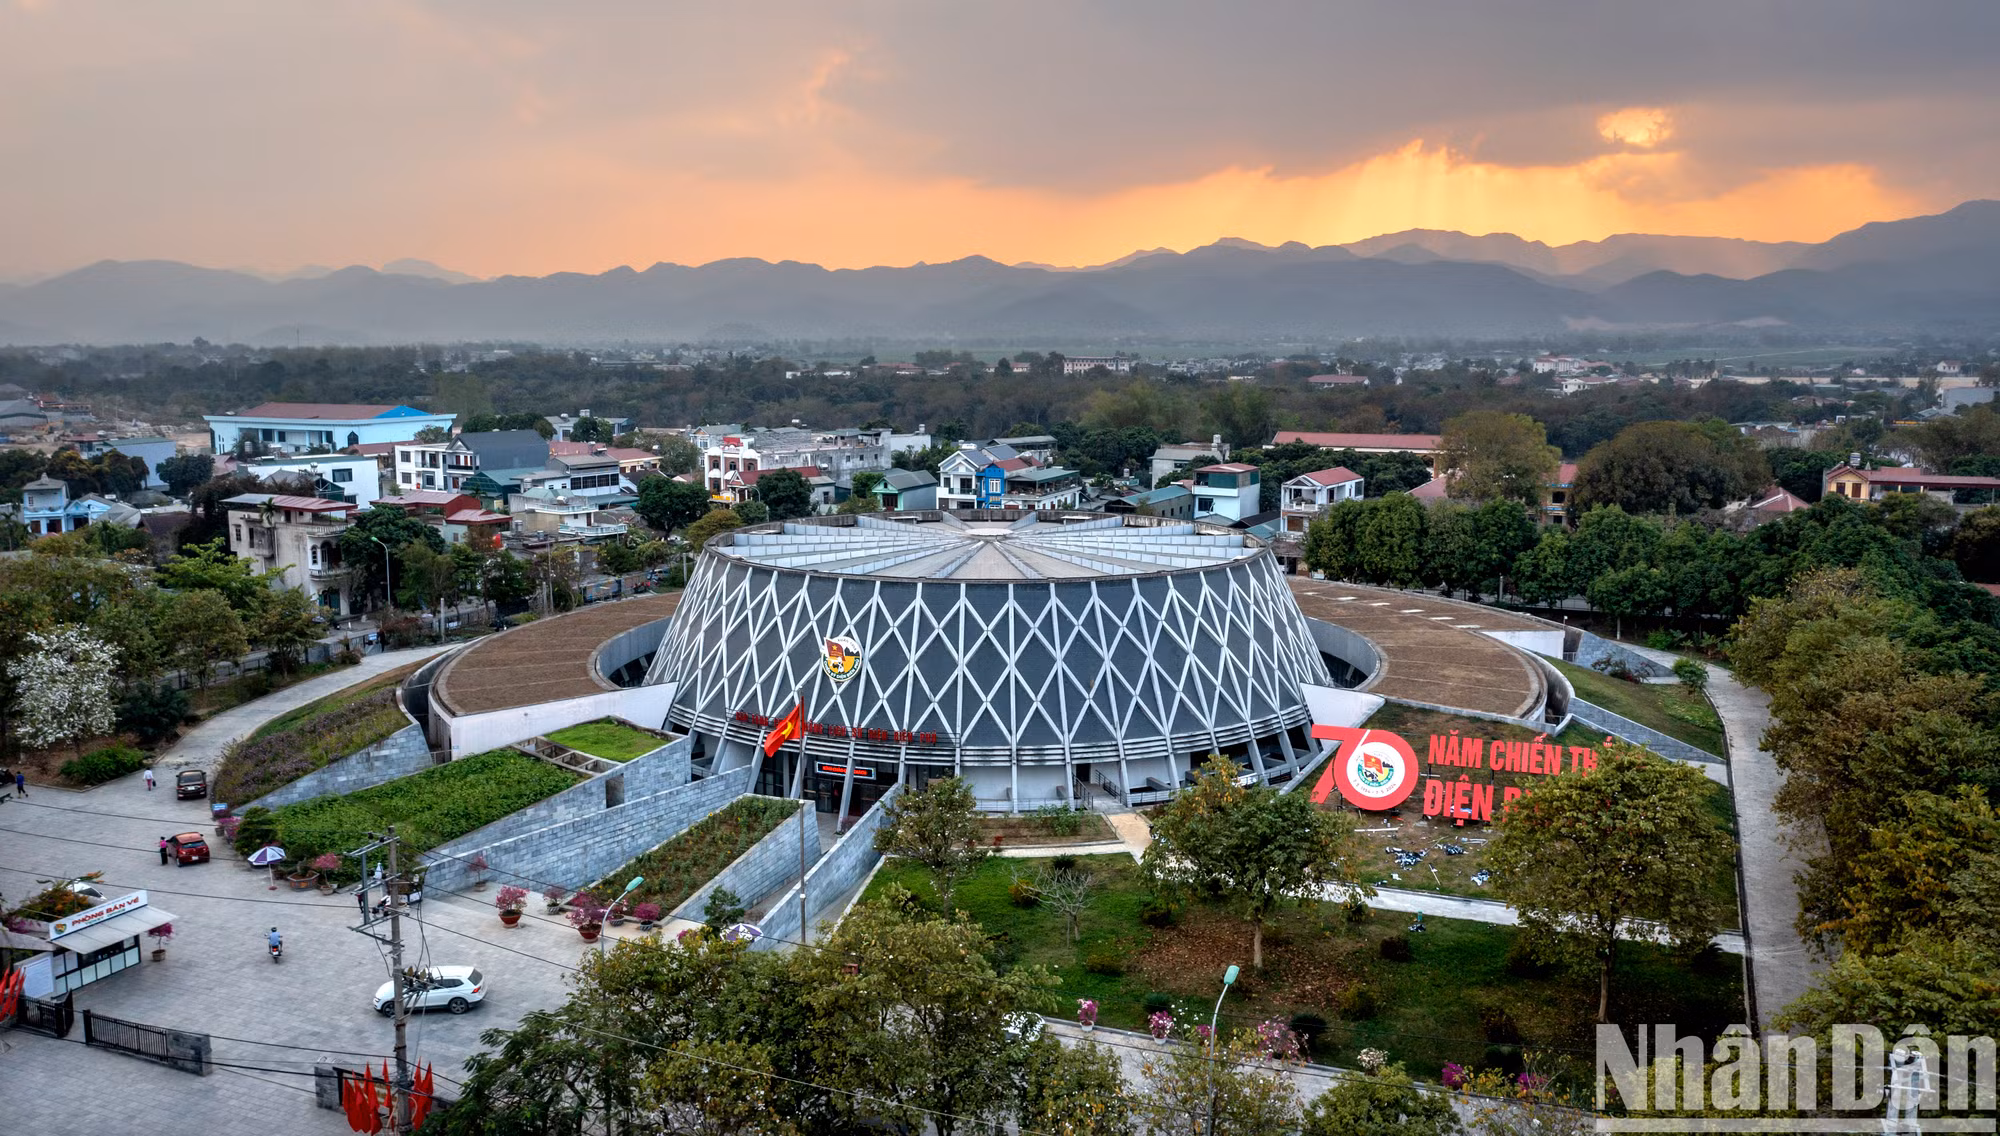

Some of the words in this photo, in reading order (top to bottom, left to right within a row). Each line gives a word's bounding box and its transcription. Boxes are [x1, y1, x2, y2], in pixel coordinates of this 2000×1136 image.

[1310, 724, 1419, 811] 70
[1428, 729, 1483, 769] NĂM
[1490, 732, 1563, 776] CHIẾN
[1423, 774, 1495, 827] ĐIỆN
[72, 909, 105, 926] PHÒNG
